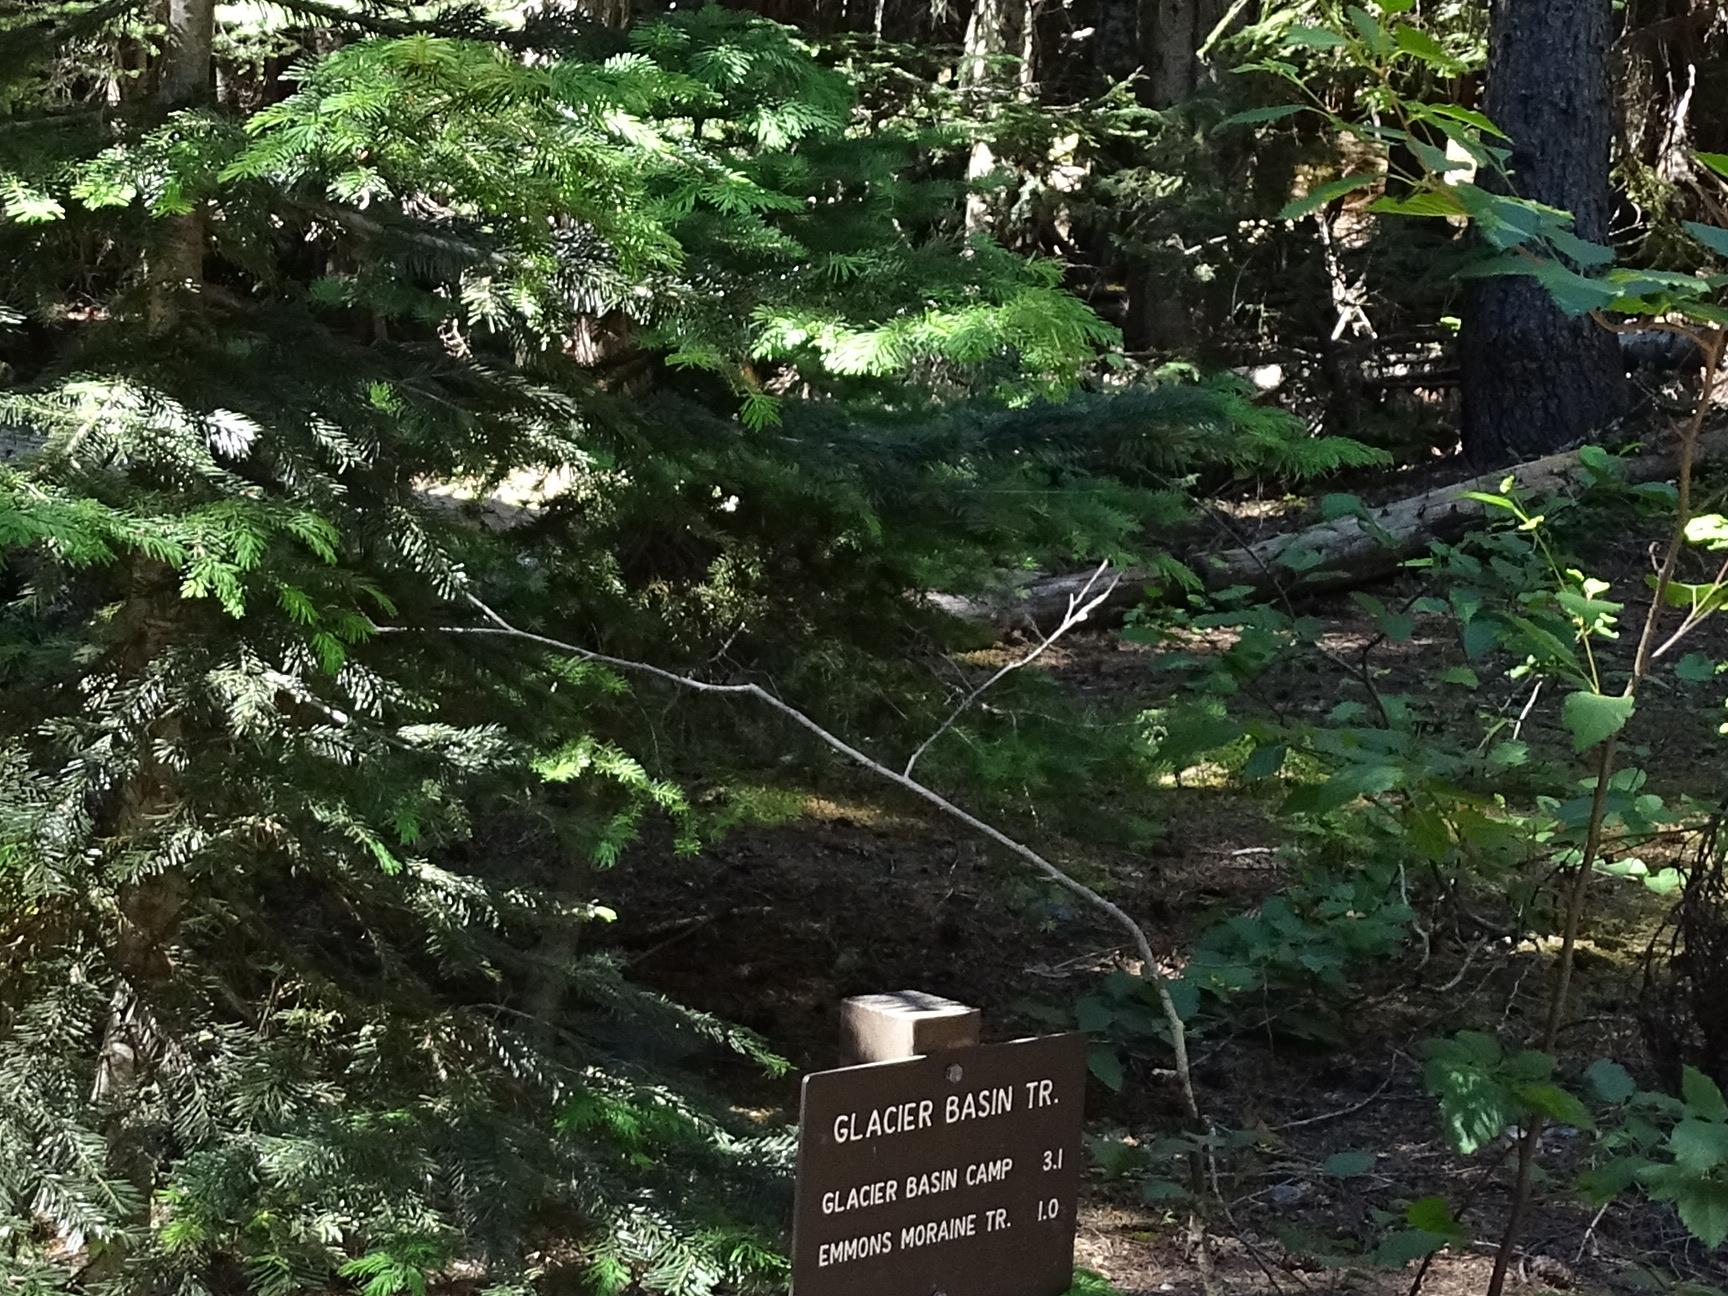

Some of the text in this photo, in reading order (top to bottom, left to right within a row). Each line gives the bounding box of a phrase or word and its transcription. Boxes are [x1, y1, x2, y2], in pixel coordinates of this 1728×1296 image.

[833, 1079, 1059, 1143] GLACIER BASIN TR.
[822, 1148, 1063, 1214] GLACIER BASIN CAMP 3.1
[818, 1198, 1059, 1267] EMMONS MORAINE TR. 1.0
